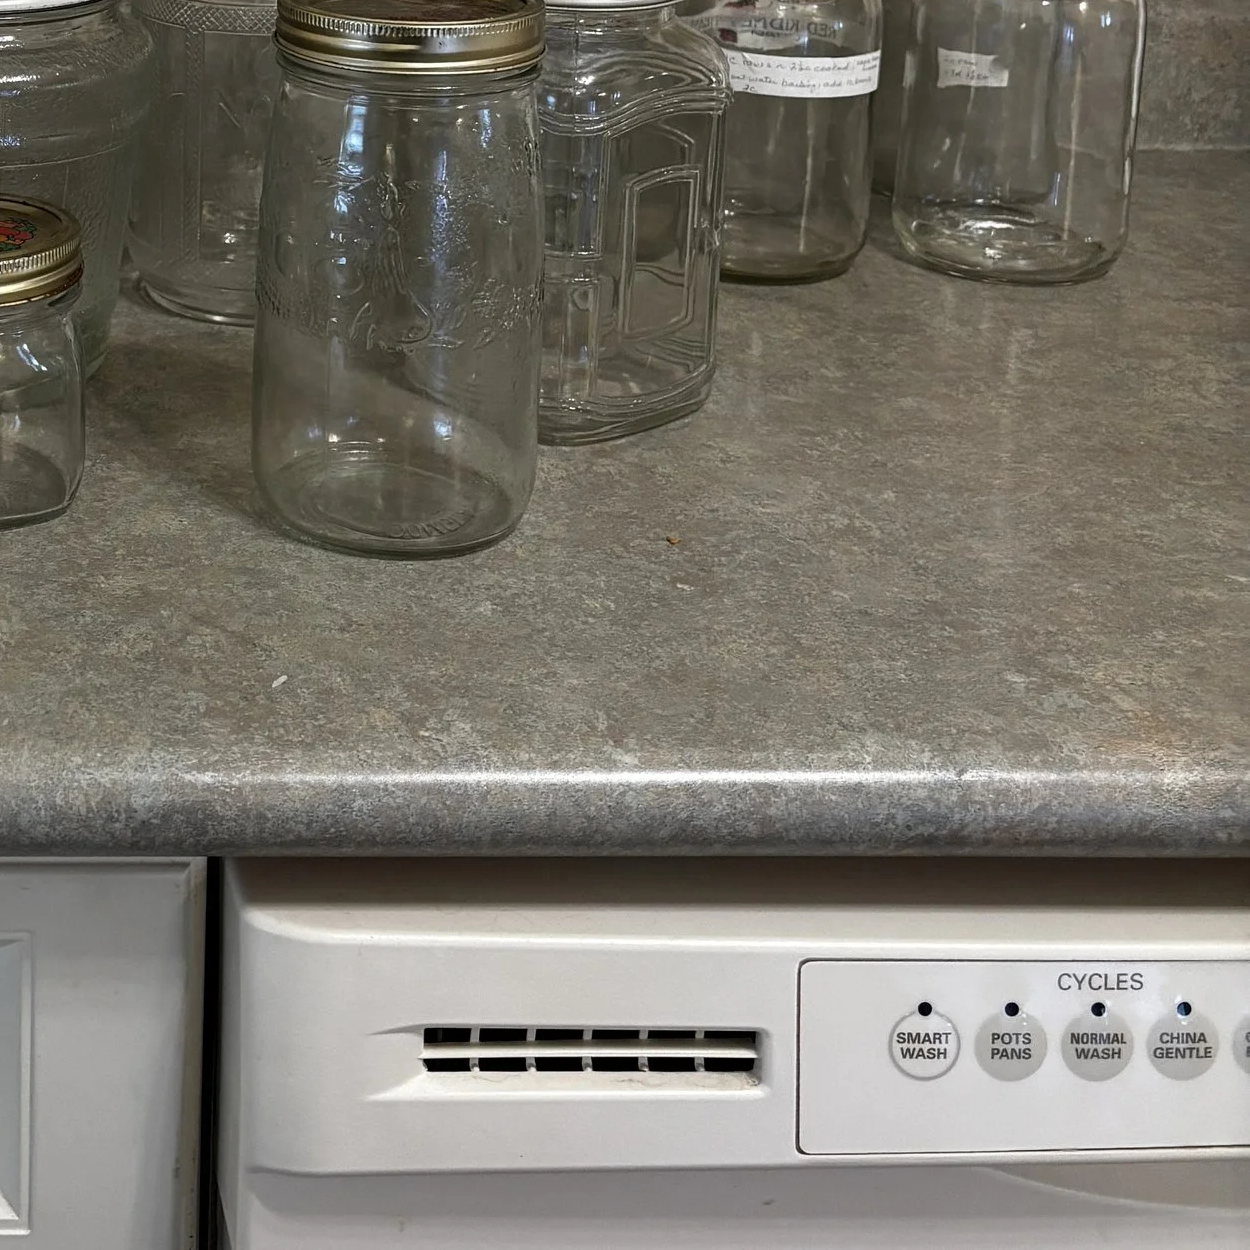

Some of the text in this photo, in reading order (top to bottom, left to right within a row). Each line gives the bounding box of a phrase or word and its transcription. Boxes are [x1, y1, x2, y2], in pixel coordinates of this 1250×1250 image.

[1057, 972, 1144, 992] CYCLES
[896, 1032, 952, 1045] SMART
[991, 1032, 1032, 1045] POTS
[1070, 1032, 1127, 1045] NORMAL
[1159, 1031, 1208, 1044] CHINA
[900, 1047, 948, 1060] WASH
[990, 1047, 1032, 1060] PANS
[1075, 1047, 1122, 1060] WASH
[1153, 1046, 1213, 1059] GENTLE
